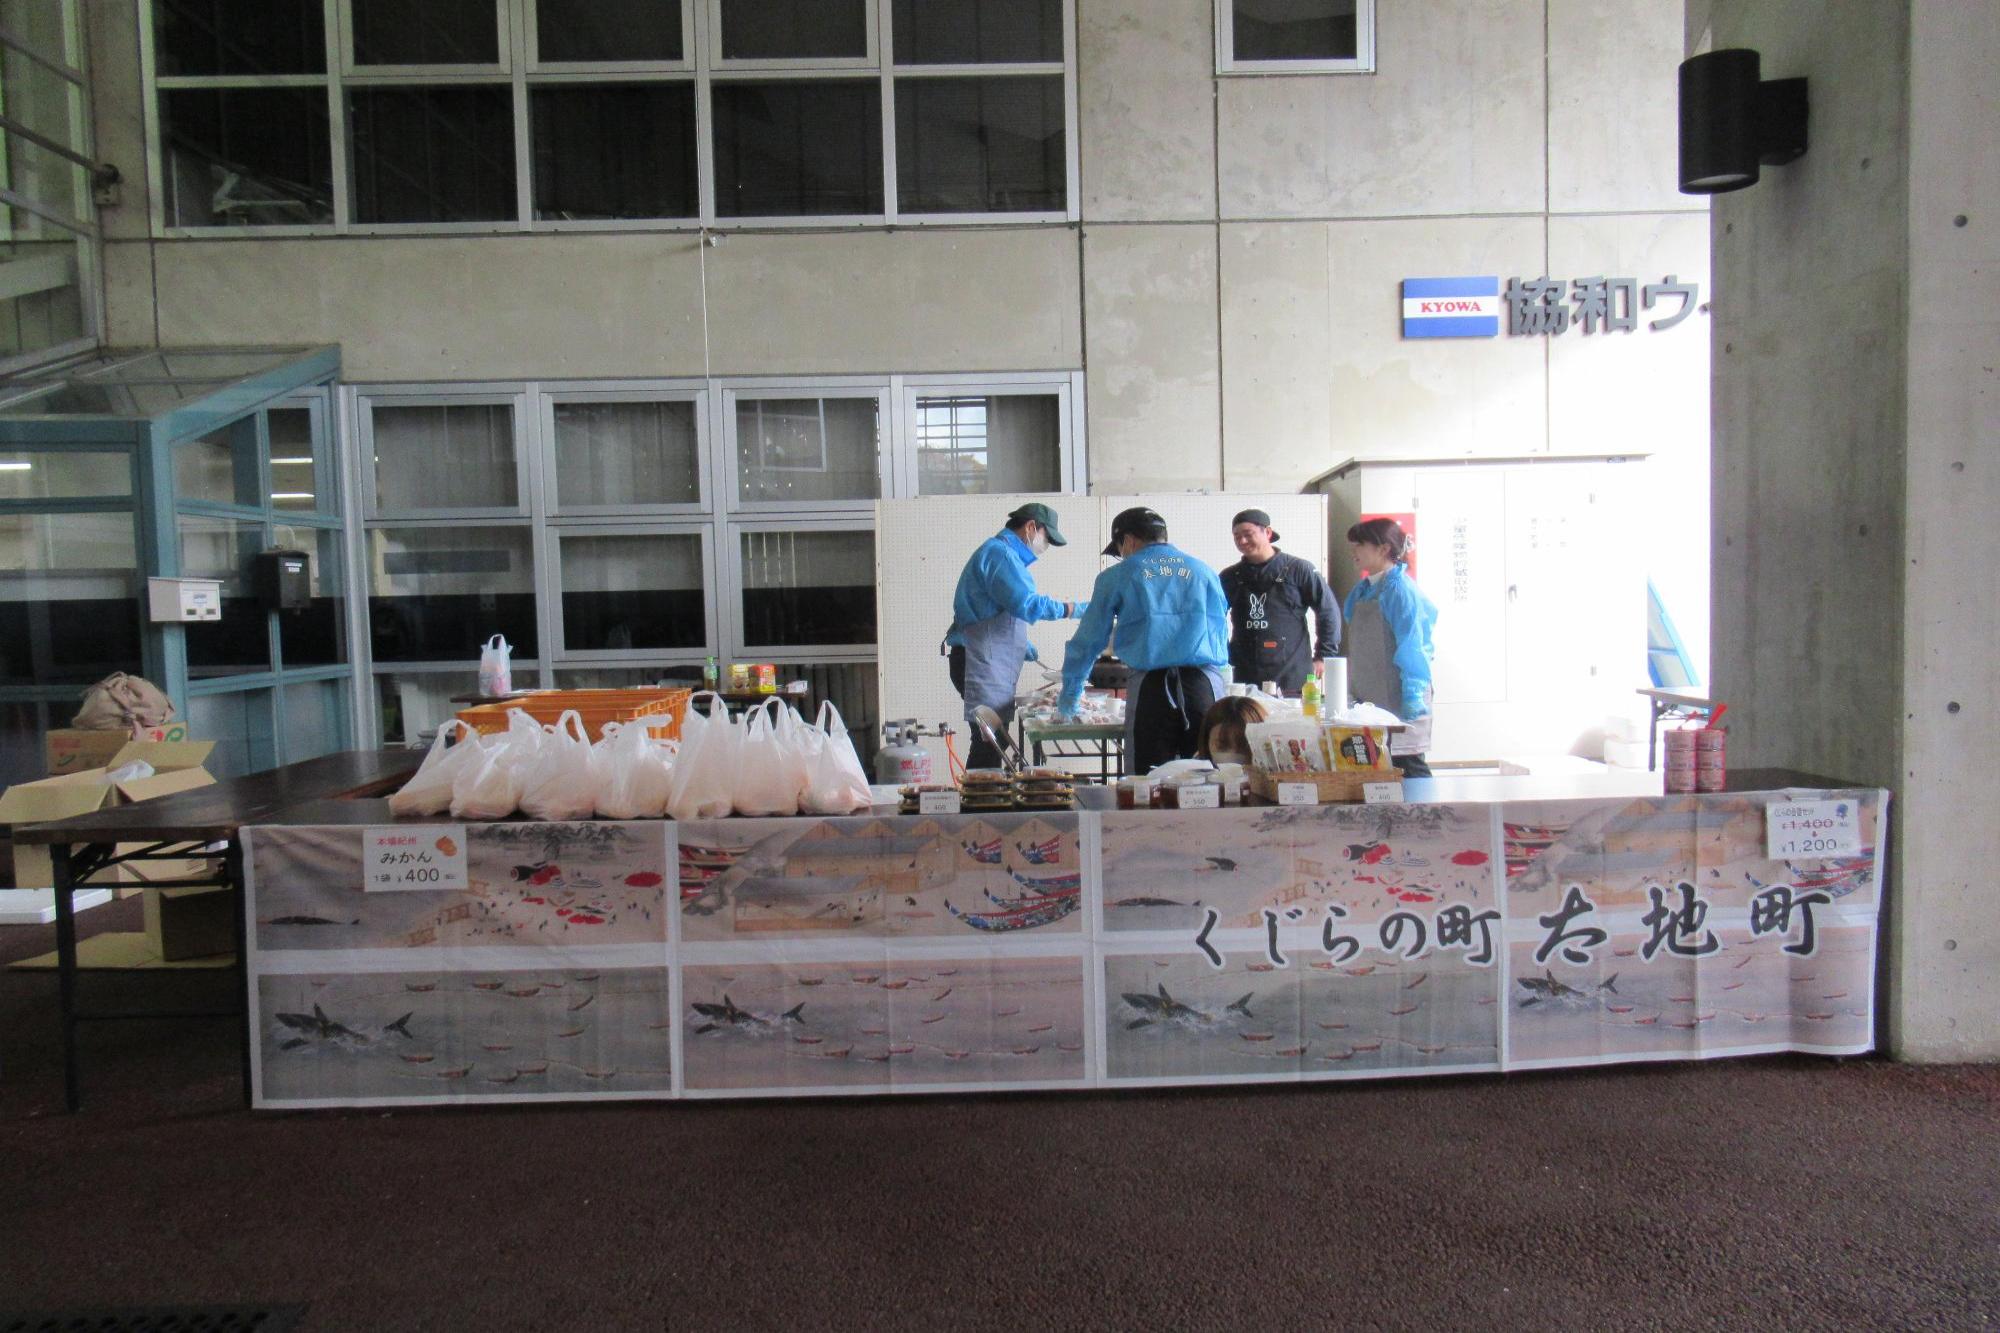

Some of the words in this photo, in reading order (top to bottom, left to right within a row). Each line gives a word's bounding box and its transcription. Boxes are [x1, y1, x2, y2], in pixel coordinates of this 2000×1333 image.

[1420, 302, 1482, 313] KYOWA
[1504, 274, 1710, 336] 協和ウ
[380, 851, 432, 864] みかん
[1195, 904, 1501, 967] くじらの町
[1535, 885, 1832, 966] 太地町
